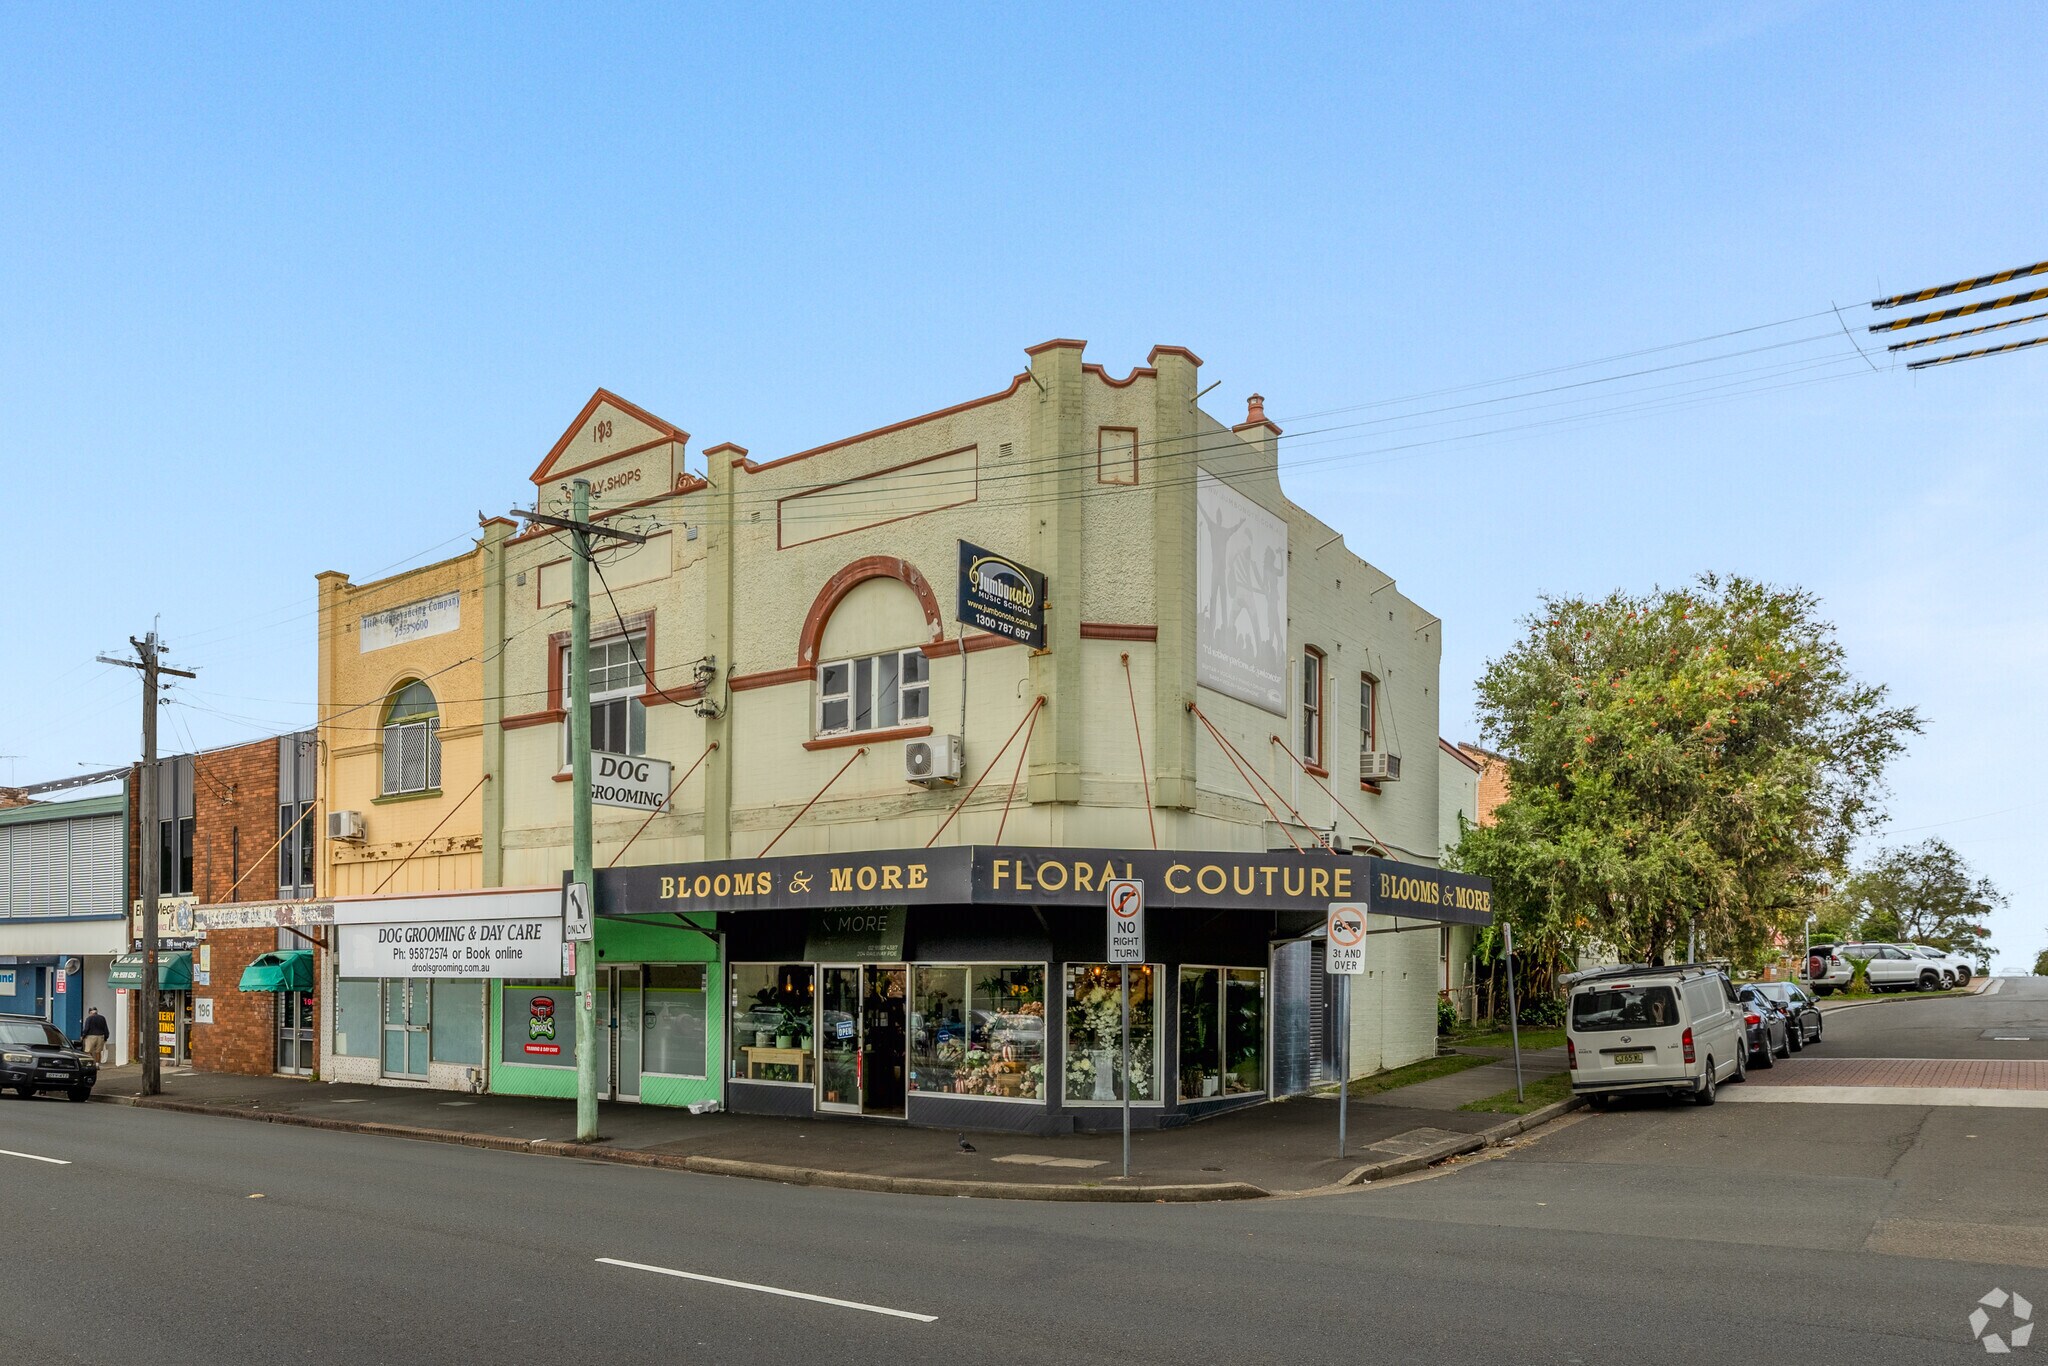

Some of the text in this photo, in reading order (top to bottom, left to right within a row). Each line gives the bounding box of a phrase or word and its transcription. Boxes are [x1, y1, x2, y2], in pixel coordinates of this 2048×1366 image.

[428, 596, 460, 612] Company
[979, 591, 1032, 616] MUSIC SCHOOL
[967, 600, 1038, 630] www.jumbonote.com.au
[976, 614, 1031, 640] 1300 787 697
[599, 757, 649, 782] DOG
[660, 864, 928, 899] BLOOMS & MORE
[1164, 864, 1351, 897] COUTURE
[1380, 873, 1491, 912] BLOOMS & MORE
[567, 923, 587, 934] ONLY
[838, 915, 888, 932] MORE
[1117, 922, 1135, 934] NO
[379, 923, 542, 943] DOG GROOMING & DAY CARE
[1113, 937, 1139, 946] RIGHT
[393, 946, 523, 960] Ph: 95872574 or Book online
[1115, 948, 1139, 958] TURN
[1333, 949, 1361, 958] 3t AND
[412, 962, 490, 974] droolsgrooming.com.au
[1334, 961, 1357, 970] OVER
[199, 1004, 211, 1017] 196
